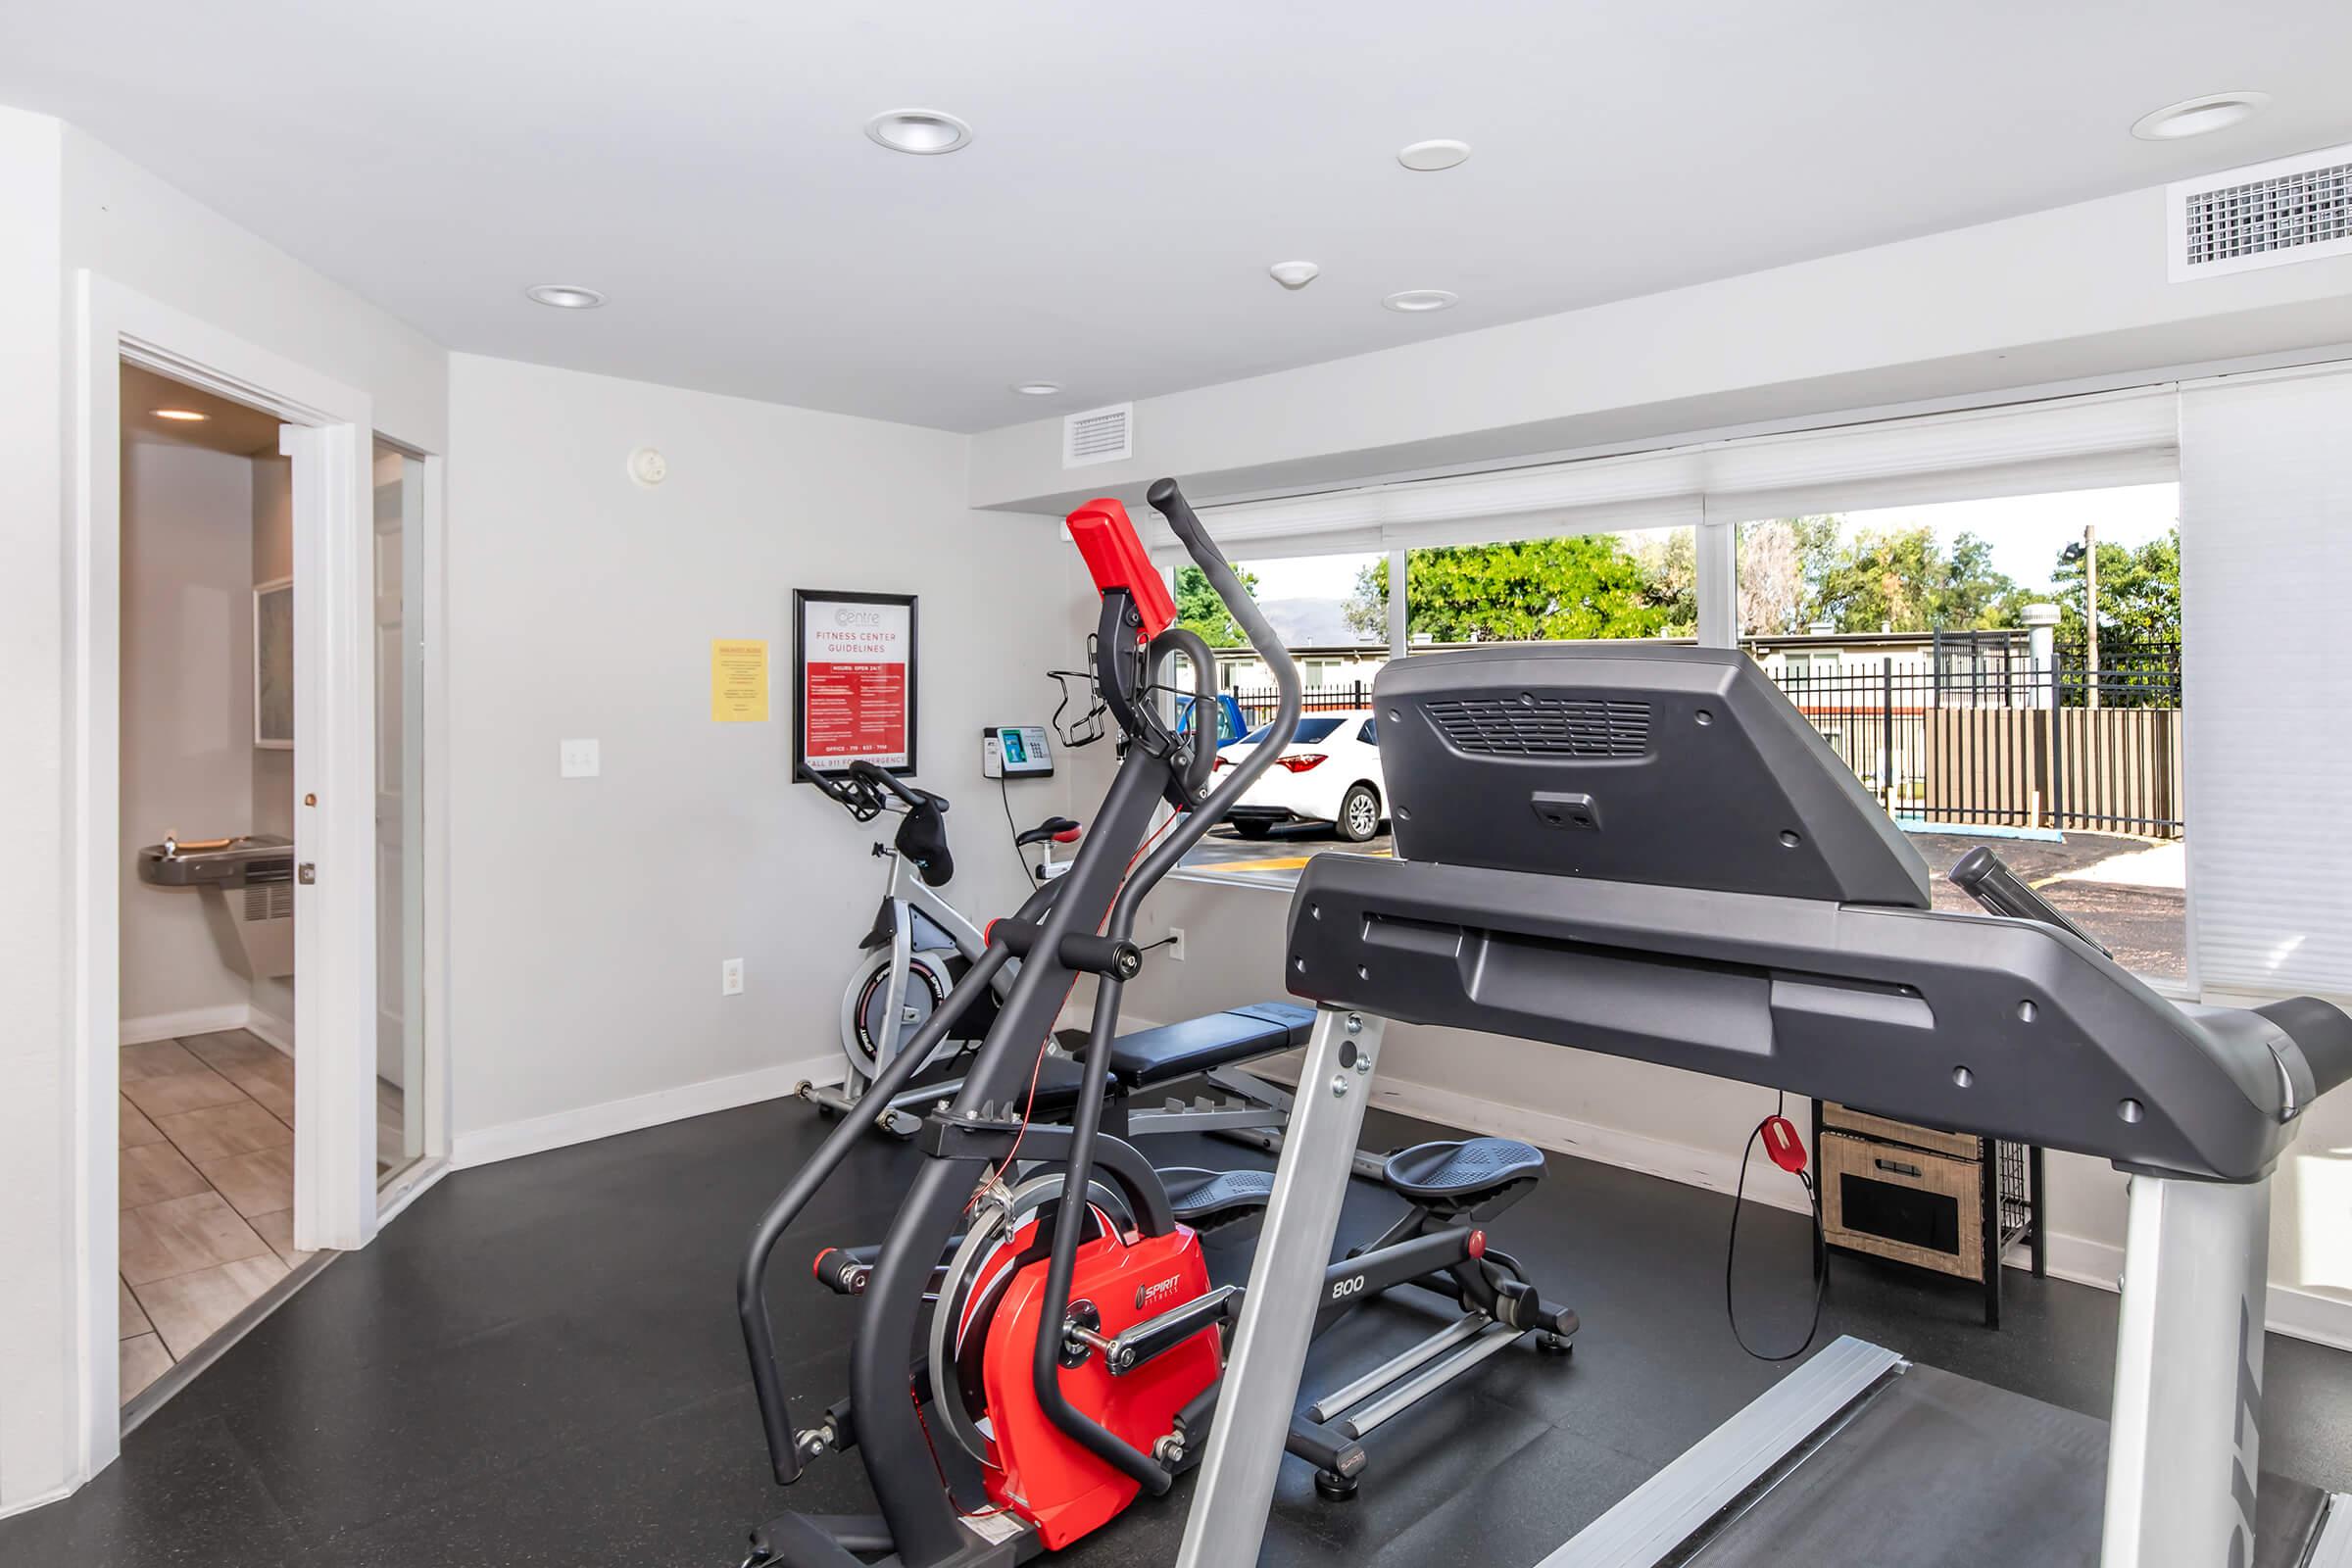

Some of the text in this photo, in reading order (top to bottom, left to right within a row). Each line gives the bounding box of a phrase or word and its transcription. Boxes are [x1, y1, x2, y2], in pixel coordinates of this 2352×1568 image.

[815, 631, 896, 642] FITNESS CENTER
[828, 644, 885, 653] GUIDELINES
[1145, 1274, 1181, 1298] SPIRIT
[1332, 1274, 1365, 1299] 800
[1144, 1287, 1179, 1310] FITNESS
